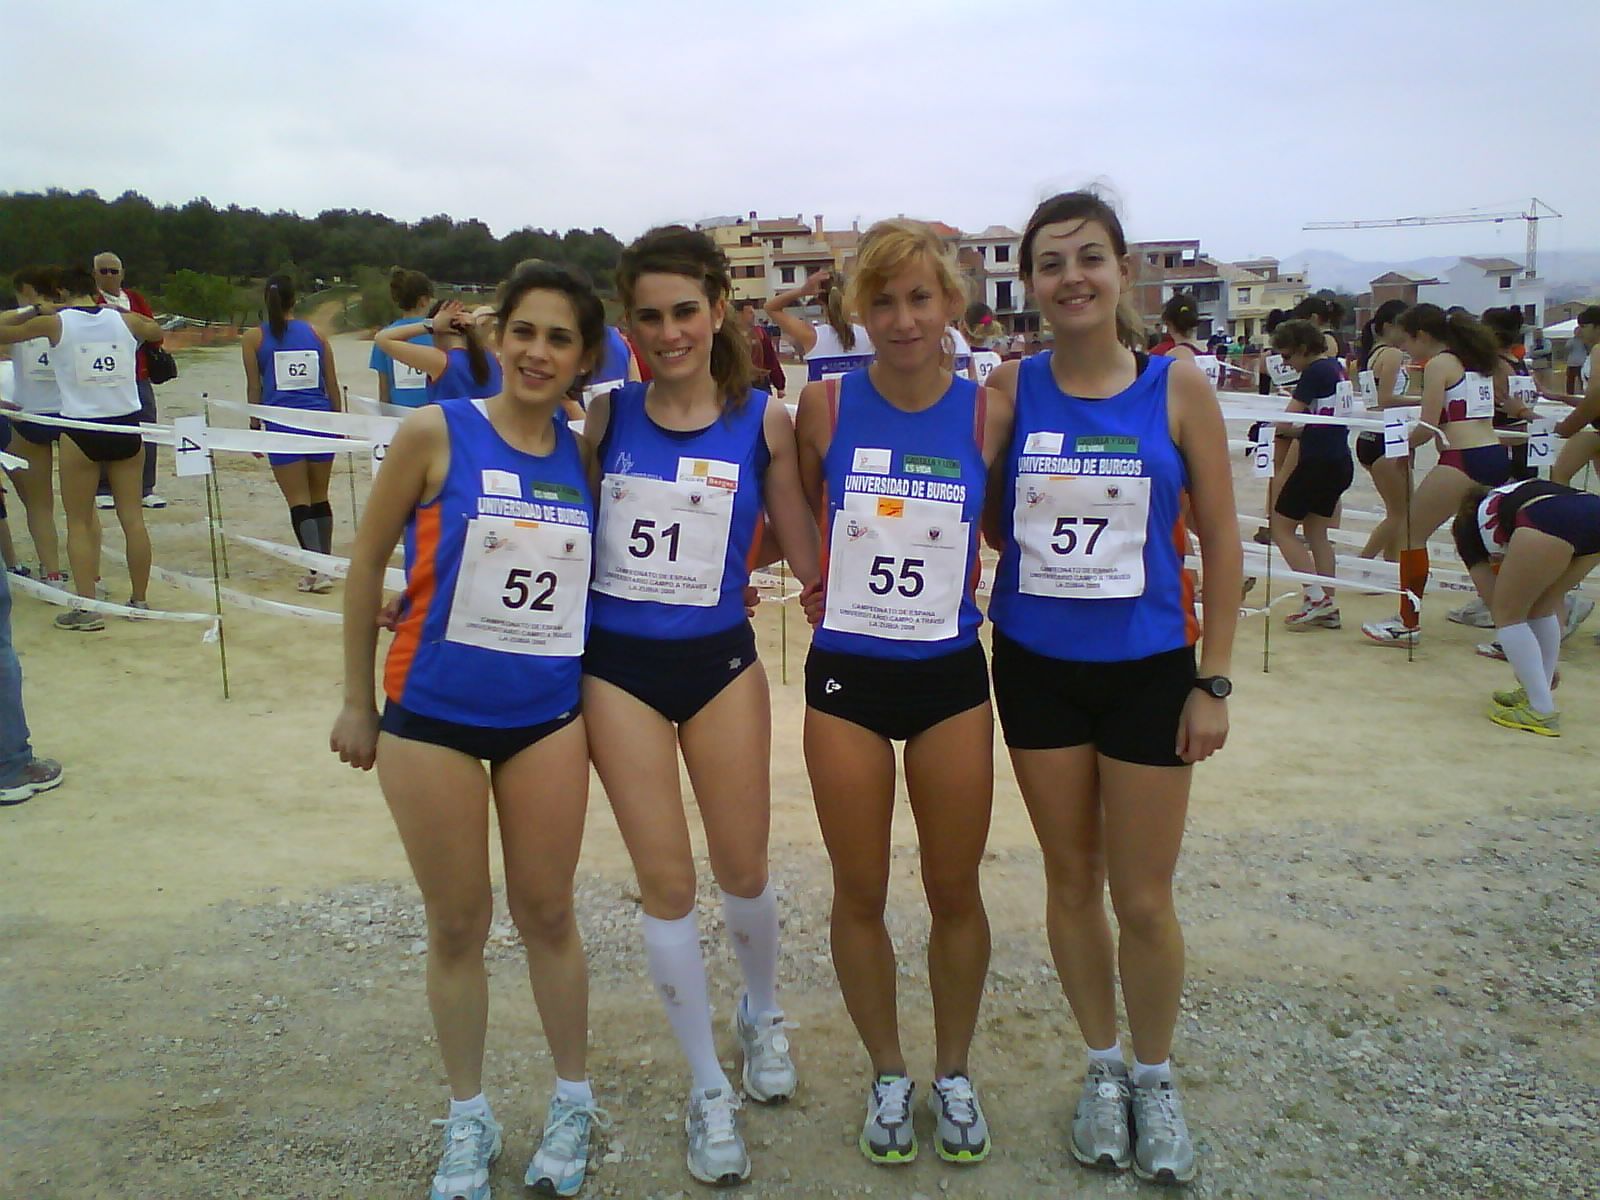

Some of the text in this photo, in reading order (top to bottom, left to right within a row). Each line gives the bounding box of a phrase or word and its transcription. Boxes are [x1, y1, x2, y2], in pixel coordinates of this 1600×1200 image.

[92, 356, 116, 372] 49
[288, 363, 307, 376] 62
[177, 437, 201, 452] 4
[1256, 440, 1269, 468] 10
[1530, 428, 1549, 457] 12
[1018, 456, 1142, 476] UNIVERSIDAD DE BURGOS
[845, 474, 966, 502] UNIVERSIDAD DE BURGOS
[477, 496, 542, 519] UNIVERSIDAD
[543, 505, 558, 521] DE
[628, 519, 681, 562] 51
[1050, 517, 1109, 555] 57
[502, 568, 558, 612] 52
[868, 556, 925, 598] 55
